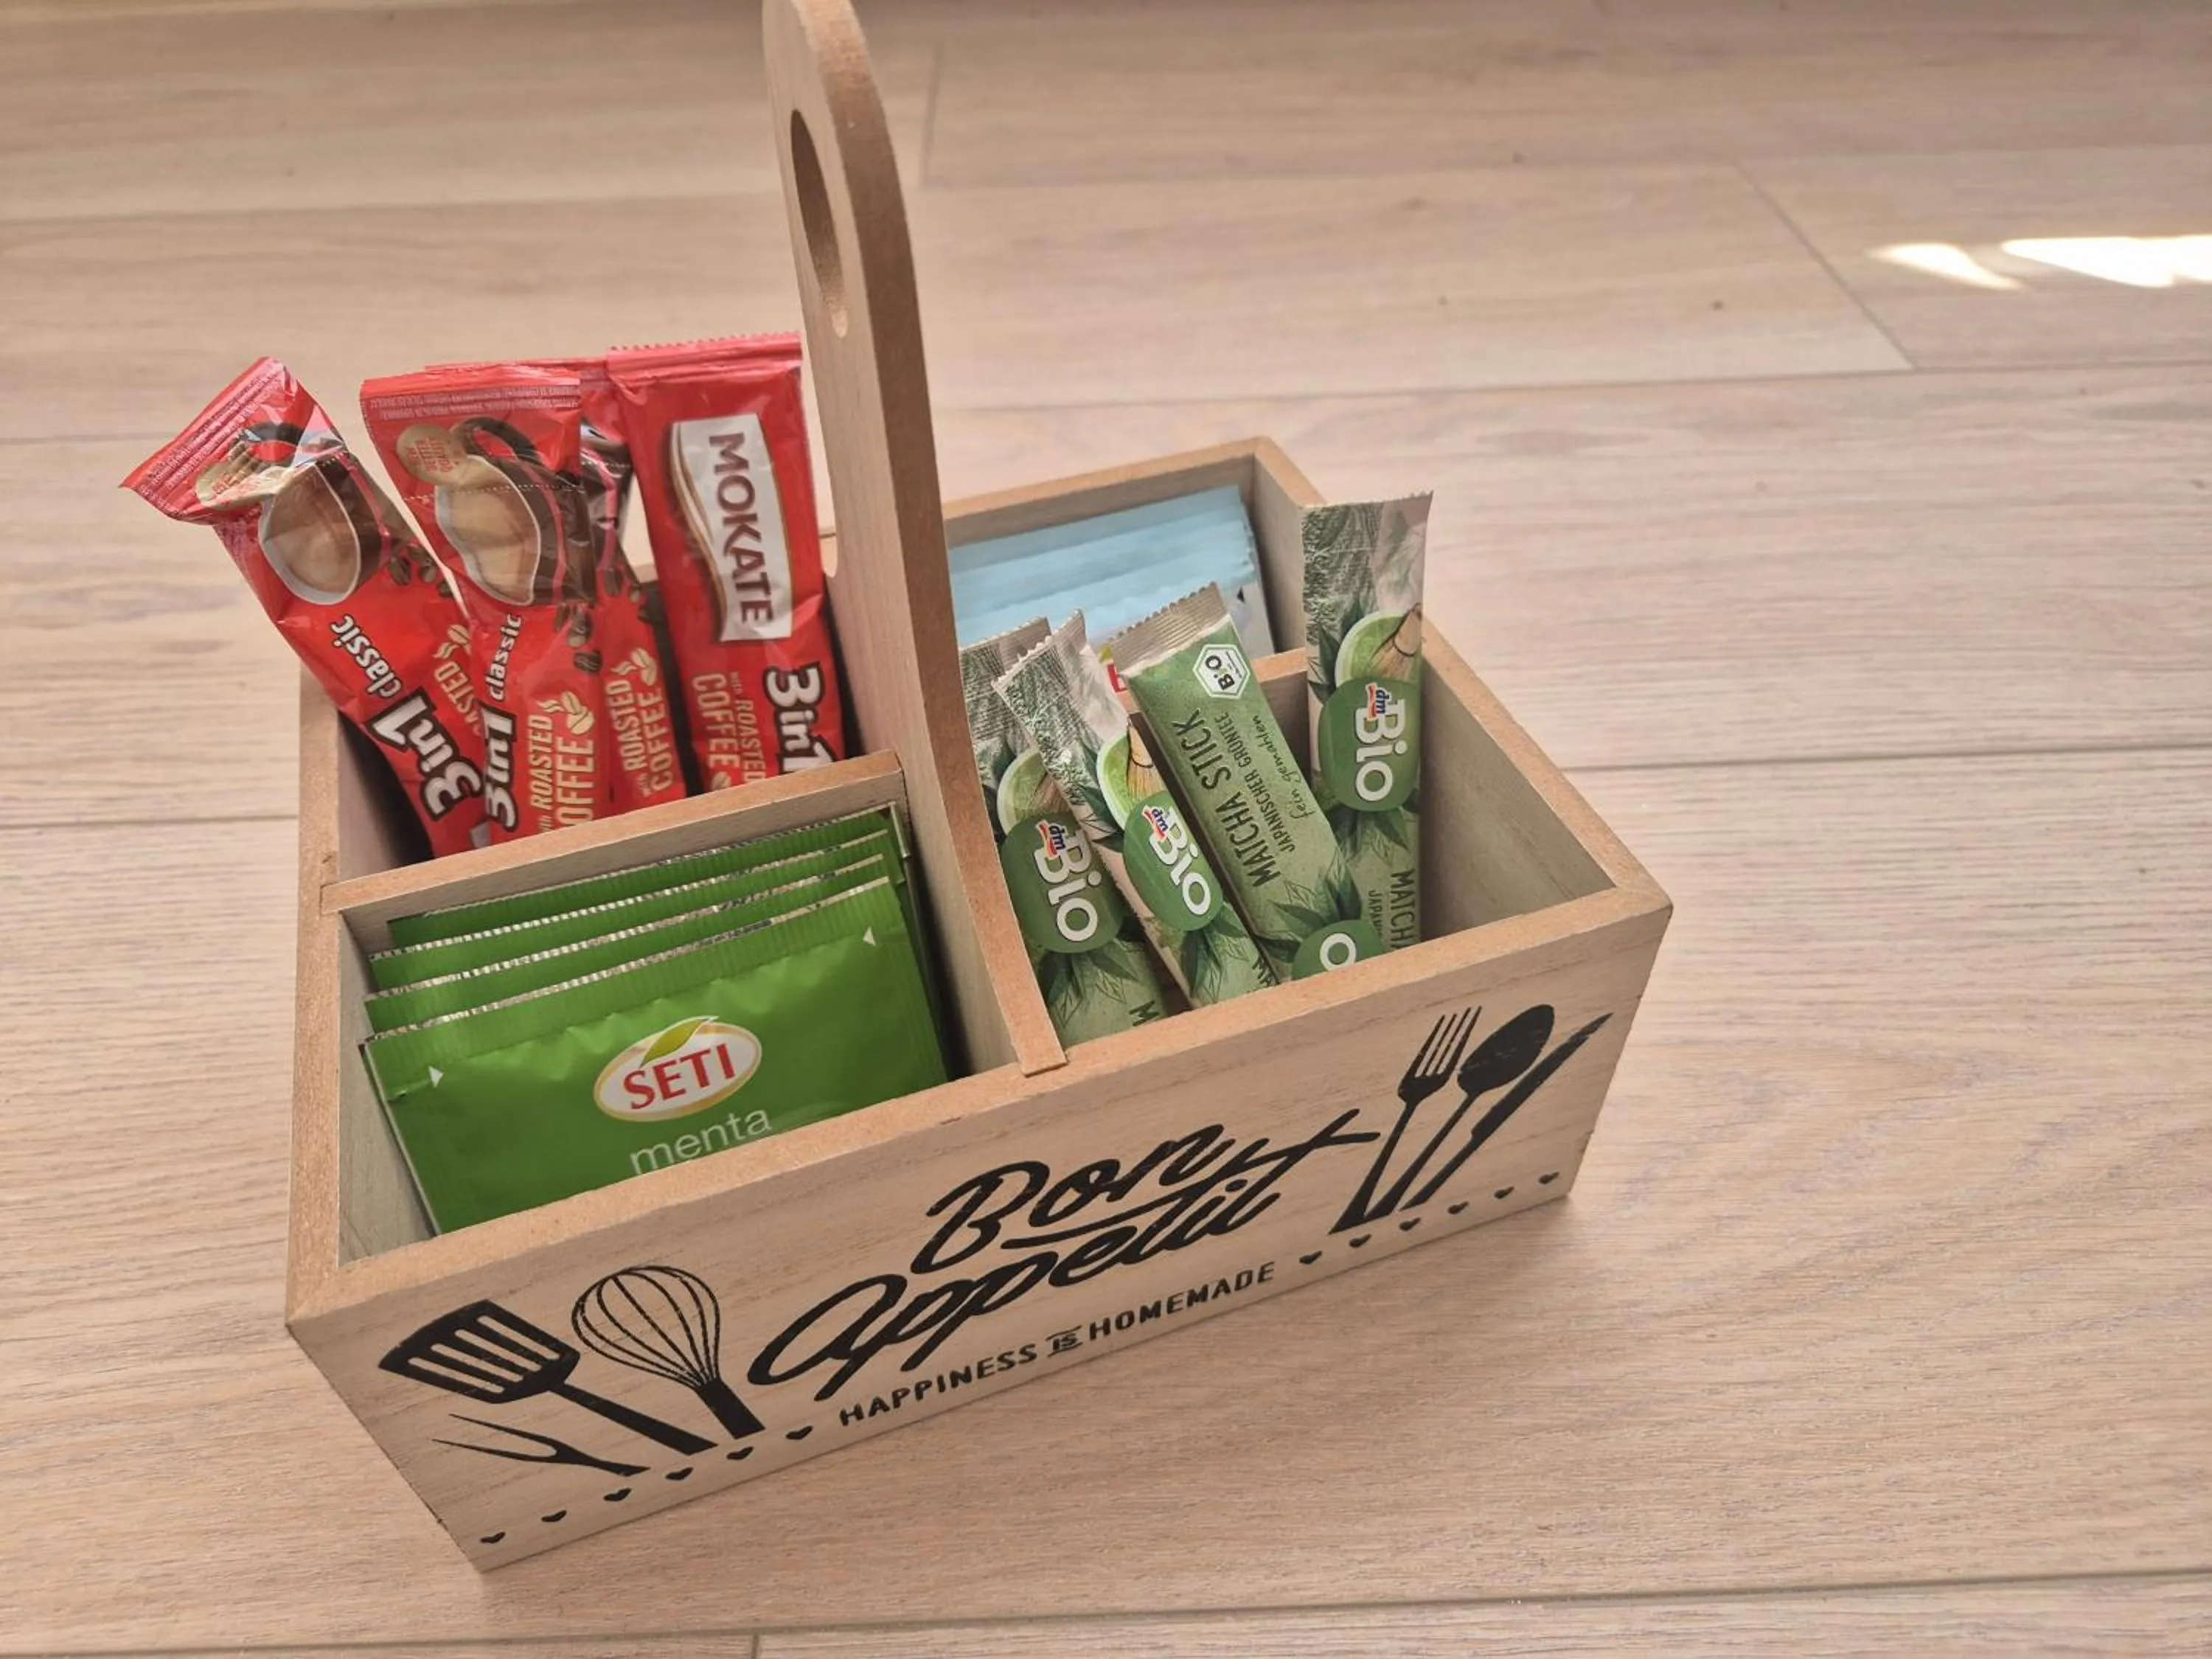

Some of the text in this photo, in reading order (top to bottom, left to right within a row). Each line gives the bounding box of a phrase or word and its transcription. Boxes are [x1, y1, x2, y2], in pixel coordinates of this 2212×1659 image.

[709, 431, 773, 625] MOKATE
[330, 613, 403, 698] classic
[434, 661, 481, 727] ASTED
[484, 613, 522, 701] classic
[369, 691, 483, 818] 3in1
[480, 702, 518, 830] 3in1
[527, 714, 554, 810] ROASTED
[605, 679, 647, 773] ROASTED
[639, 687, 673, 792] COFFEE
[692, 672, 742, 768] COFFEE
[734, 699, 767, 782] ROASTED
[765, 664, 835, 773] 3in1
[1172, 708, 1231, 790] STICK
[1354, 699, 1408, 802] Bio
[555, 737, 594, 827] OFFEE
[1244, 769, 1295, 852] JAPANISCHER
[1034, 829, 1102, 942] Bio
[1149, 806, 1211, 916] Bio
[1215, 791, 1281, 887] MATCHA
[1391, 869, 1416, 950] MATCH
[623, 1043, 736, 1110] SETI
[629, 1109, 773, 1175] menta
[911, 1123, 1237, 1276] Bon
[838, 1261, 1276, 1427] HAPPINESS IS HOMEMADE
